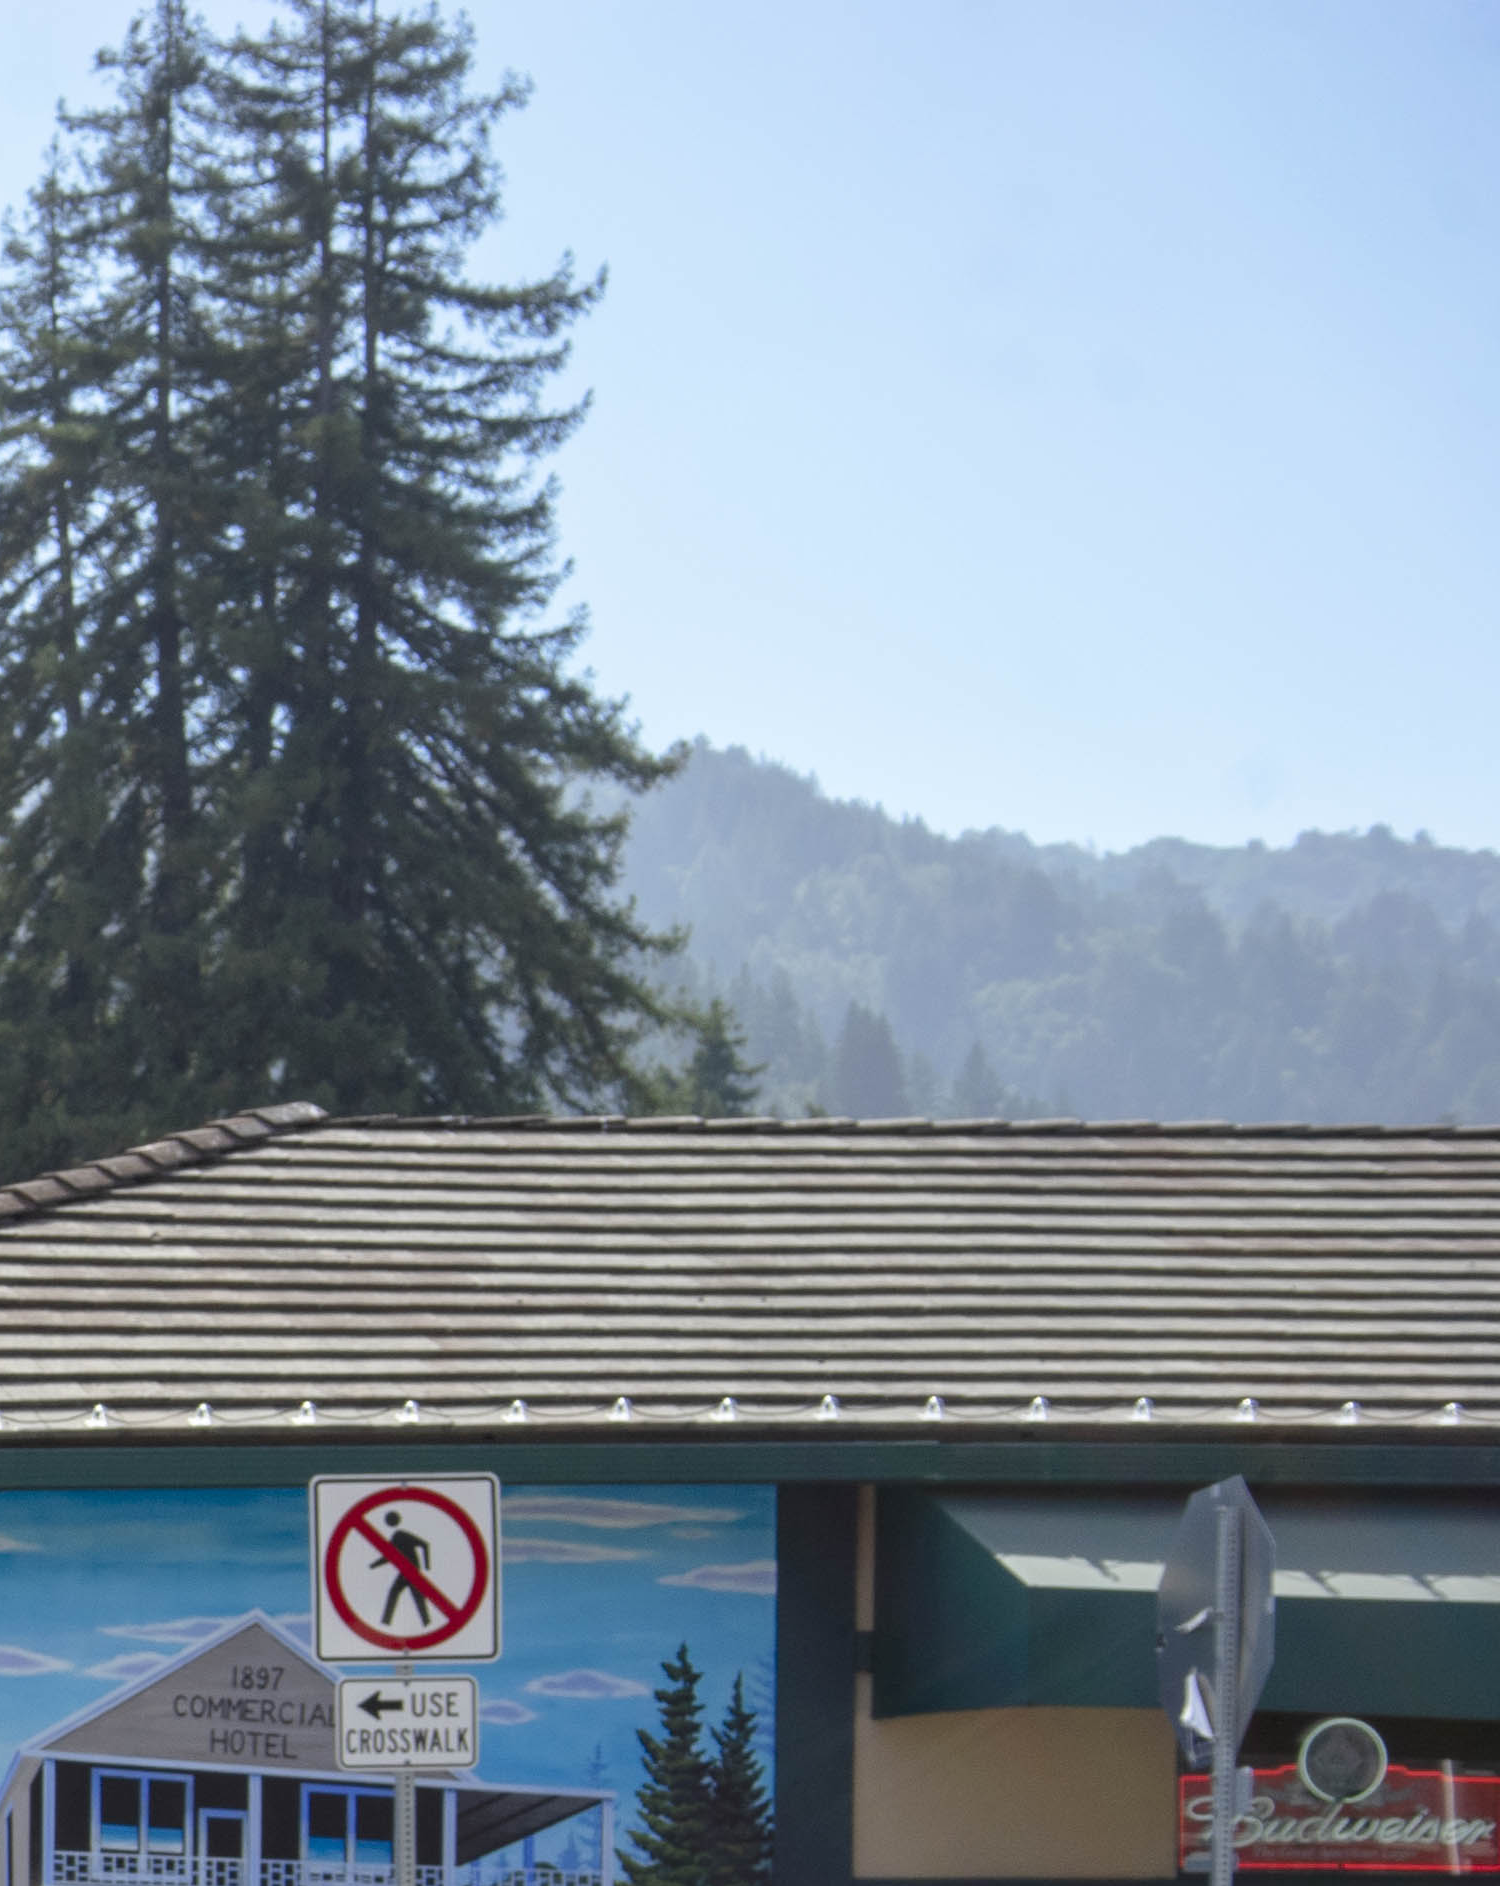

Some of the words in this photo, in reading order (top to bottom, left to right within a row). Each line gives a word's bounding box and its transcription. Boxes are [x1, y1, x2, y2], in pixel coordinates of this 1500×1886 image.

[231, 1664, 285, 1691] 1897
[172, 1694, 335, 1728] COMMERCIAL
[411, 1692, 460, 1718] USE
[209, 1728, 298, 1760] HOTEL
[346, 1728, 469, 1754] CROSSWALK
[1186, 1796, 1498, 1848] Budweiser
